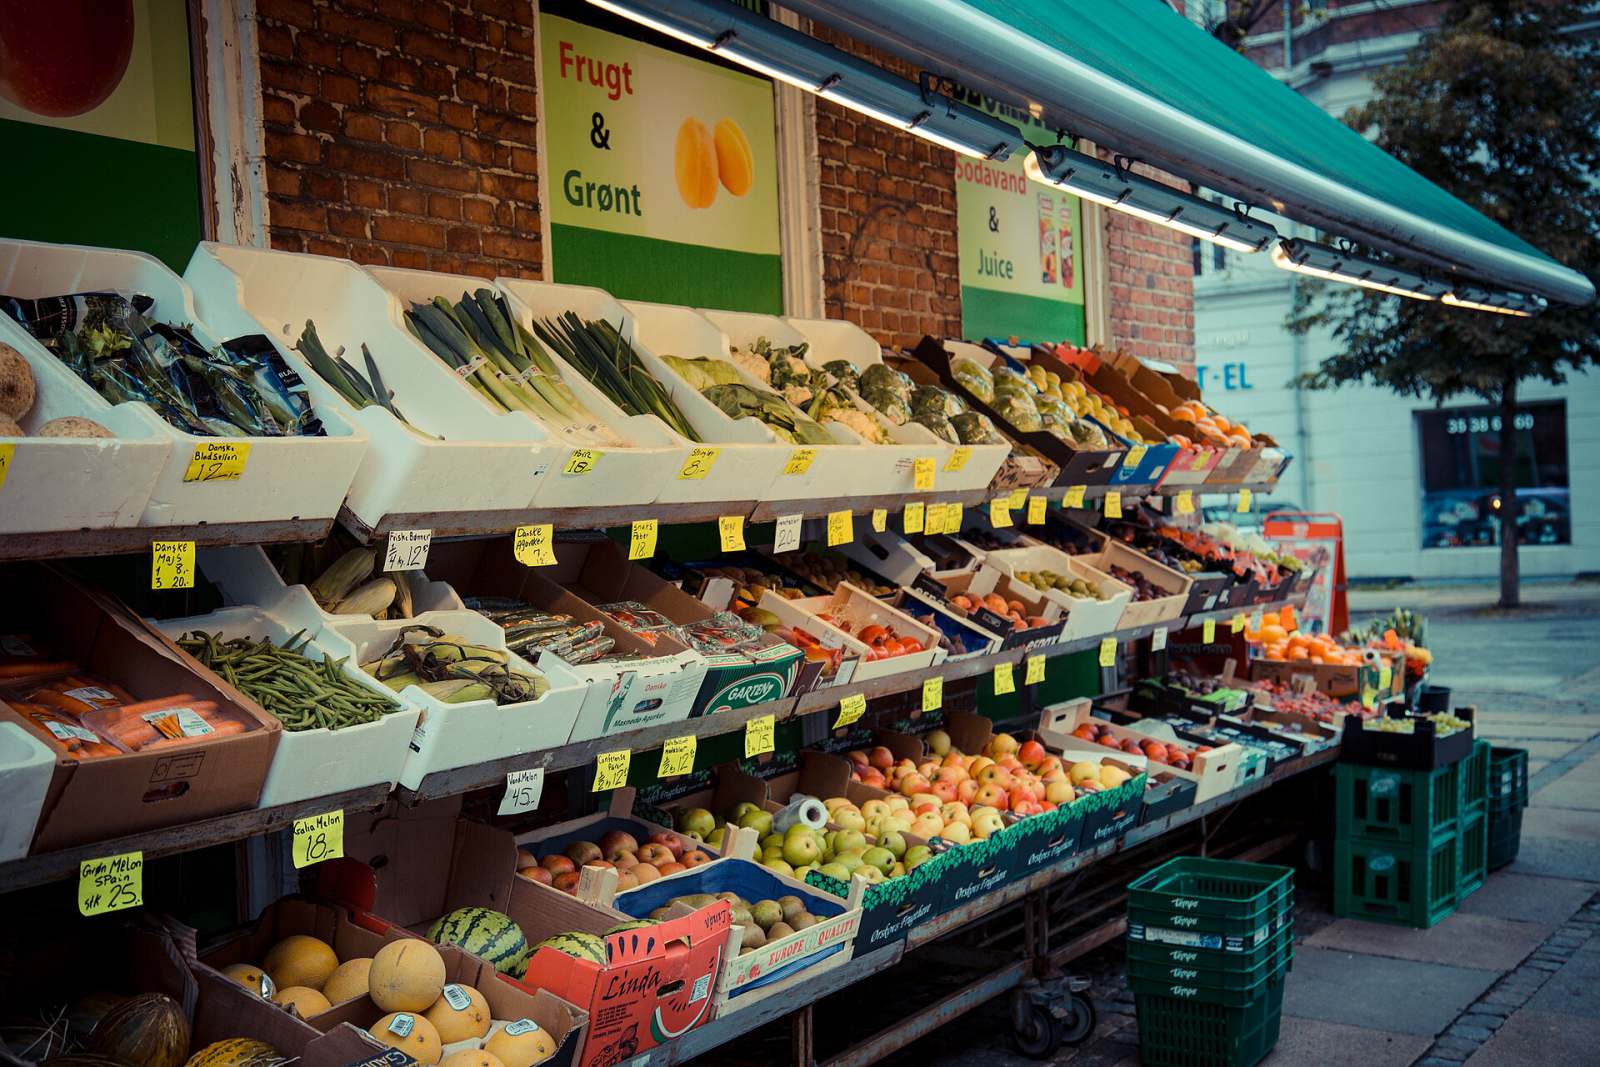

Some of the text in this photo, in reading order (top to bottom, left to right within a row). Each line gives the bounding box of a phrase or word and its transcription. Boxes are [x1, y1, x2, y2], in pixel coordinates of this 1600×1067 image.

[558, 41, 634, 101] Frugt
[589, 112, 612, 151] &
[563, 168, 643, 217] Grønt
[955, 152, 1027, 195] Sodavand
[989, 206, 1000, 233] &
[978, 248, 1013, 279] Juice
[315, 815, 341, 829] Melon
[768, 918, 854, 966] EUROPE QUALITY
[602, 966, 661, 1001] Linda
